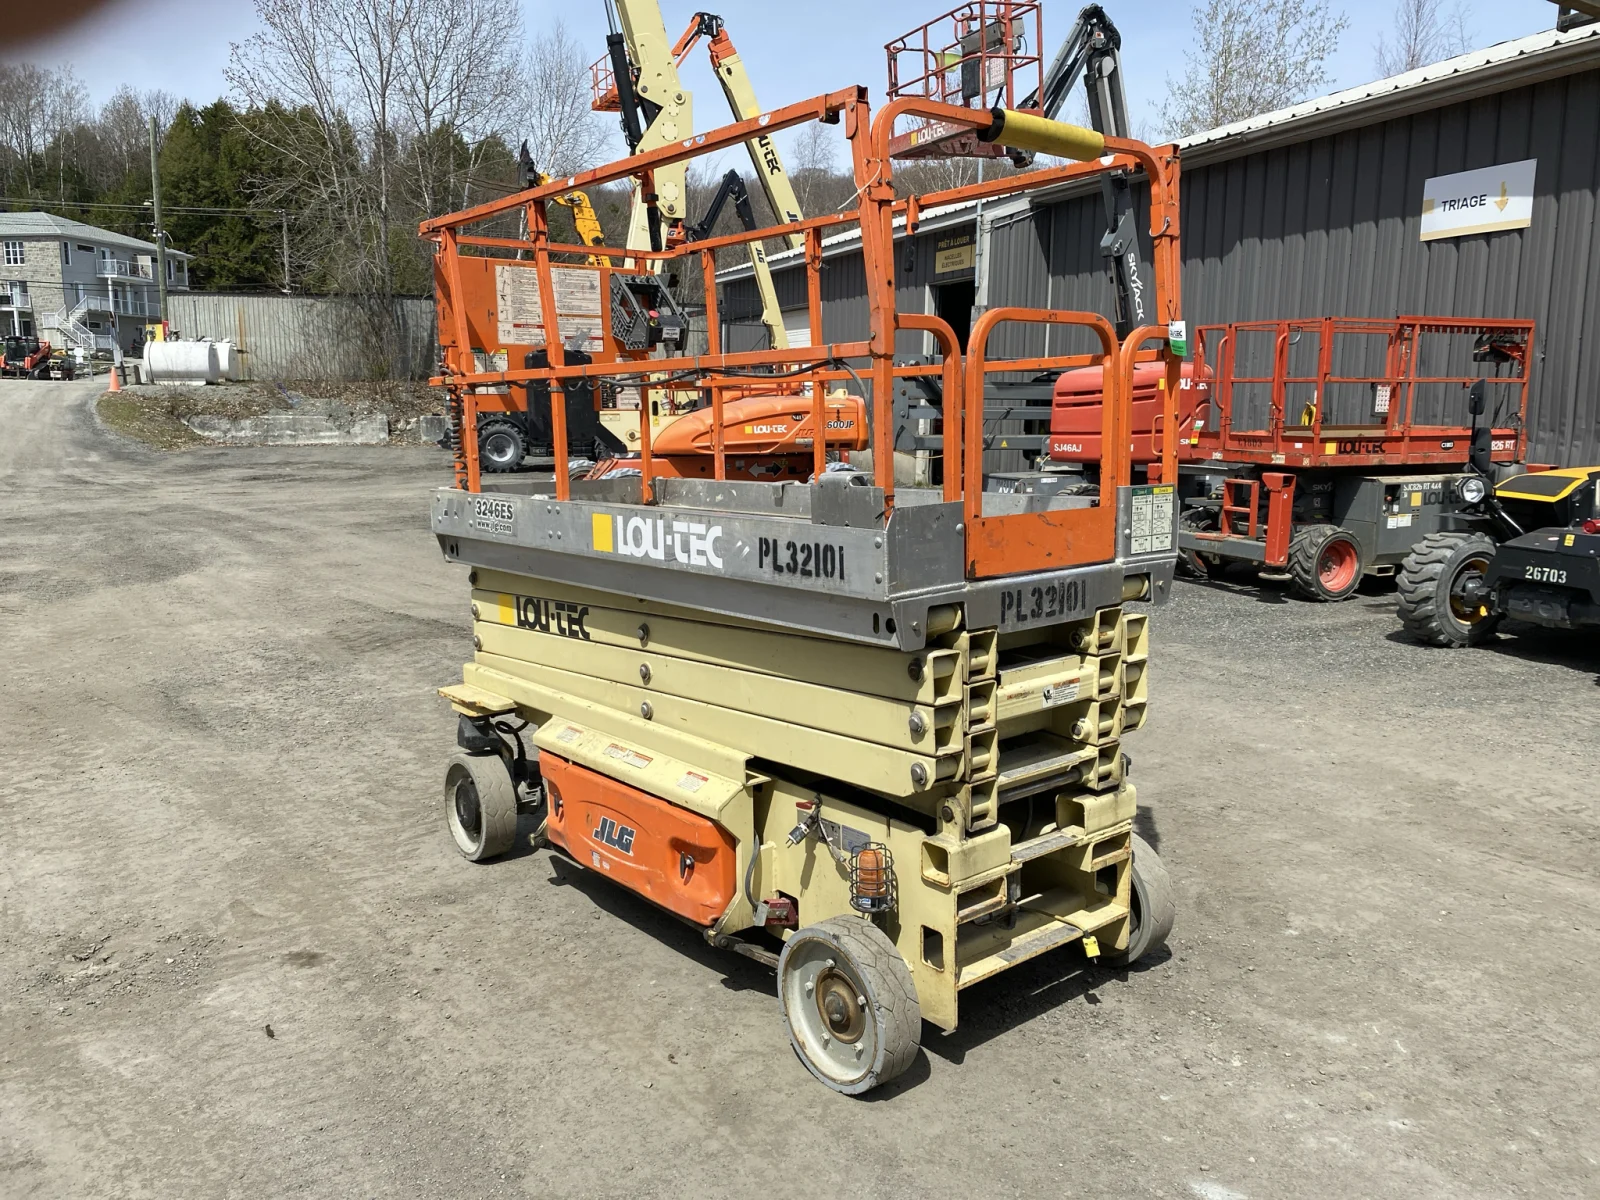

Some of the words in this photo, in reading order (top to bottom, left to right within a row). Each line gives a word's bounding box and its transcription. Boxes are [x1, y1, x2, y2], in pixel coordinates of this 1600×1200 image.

[757, 133, 781, 176] U-TEC
[1441, 194, 1487, 212] TRIAGE
[954, 235, 970, 245] LOUER
[755, 247, 766, 264] JLG
[1127, 252, 1145, 321] SKYJACK
[753, 424, 788, 434] LOU-TEC
[824, 420, 855, 429] 600JP
[1053, 443, 1083, 453] SJ46AJ
[1338, 440, 1387, 454] LOU-TEC
[1505, 440, 1516, 450] RT
[475, 499, 514, 521] 3246ES
[617, 515, 723, 569] LOU-TEC
[758, 537, 845, 579] PL32101
[1525, 565, 1567, 584] 26703
[1001, 579, 1087, 624] PL32101
[516, 596, 591, 640] LOU-TEC
[592, 815, 636, 856] JLG
